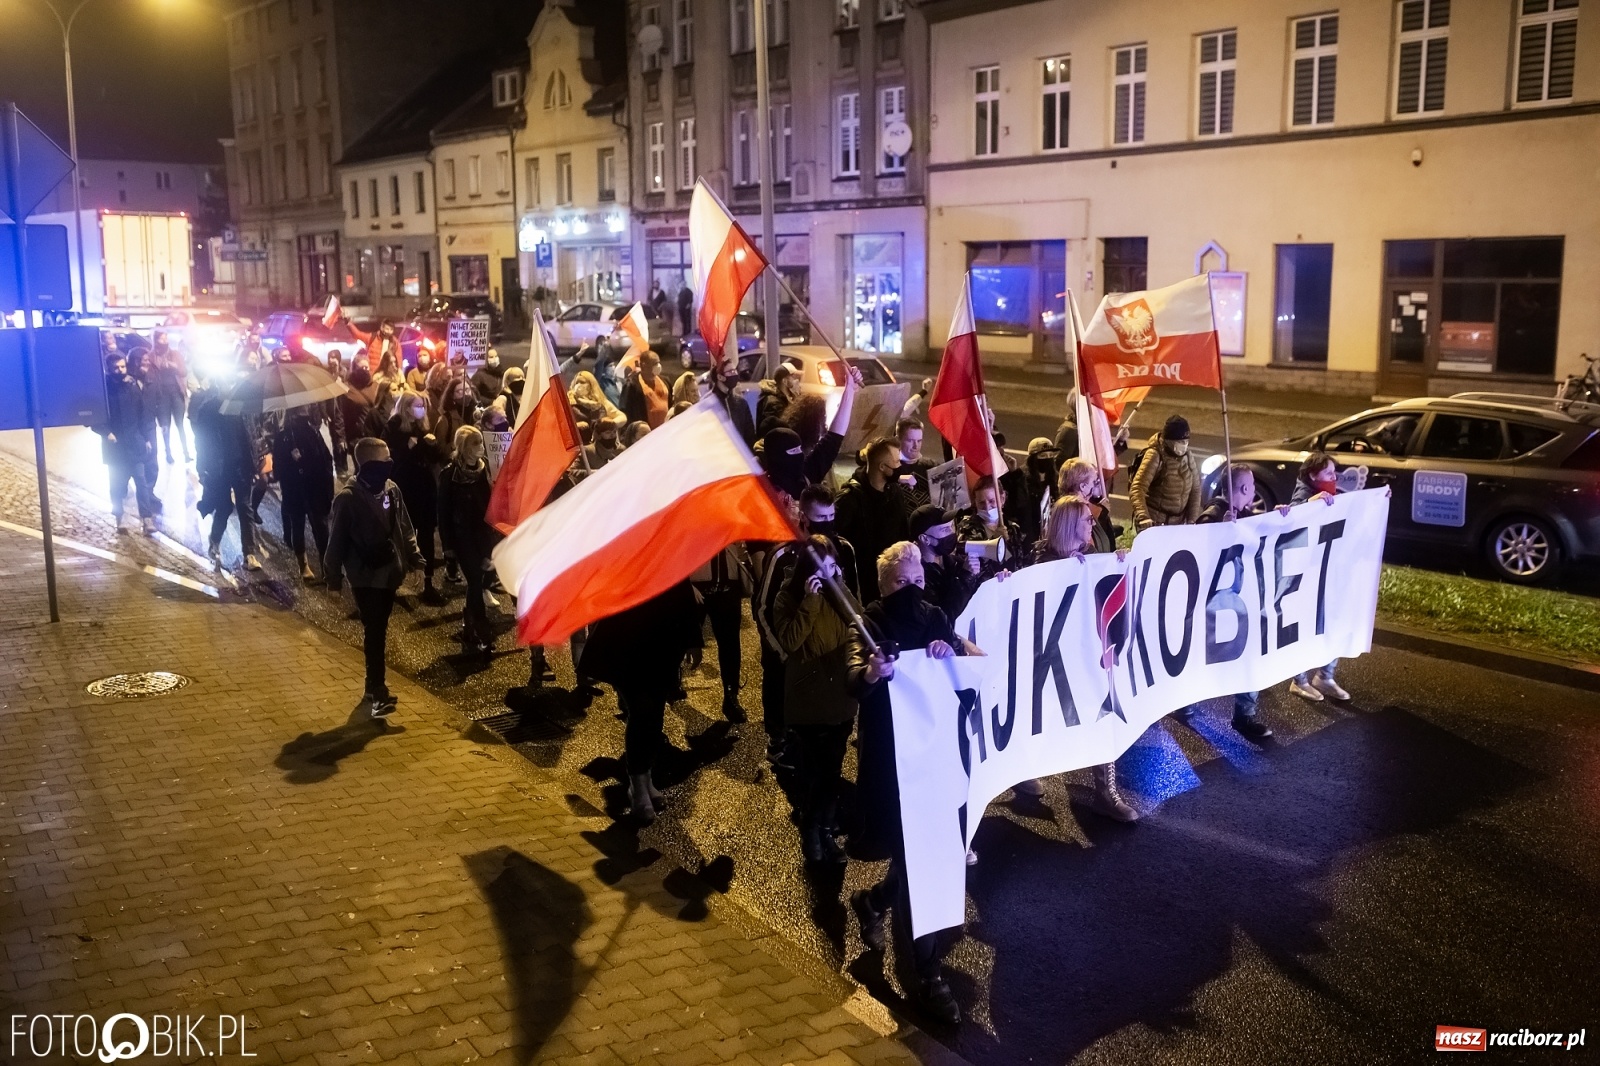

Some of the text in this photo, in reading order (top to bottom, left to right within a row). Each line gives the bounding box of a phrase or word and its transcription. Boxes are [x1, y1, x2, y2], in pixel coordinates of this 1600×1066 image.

[539, 244, 549, 260] P
[450, 322, 469, 330] NAWET
[450, 331, 458, 339] NIE
[1417, 476, 1462, 486] FABRYKA
[1417, 484, 1462, 496] URODY
[957, 520, 1346, 778] AJK KOBIET
